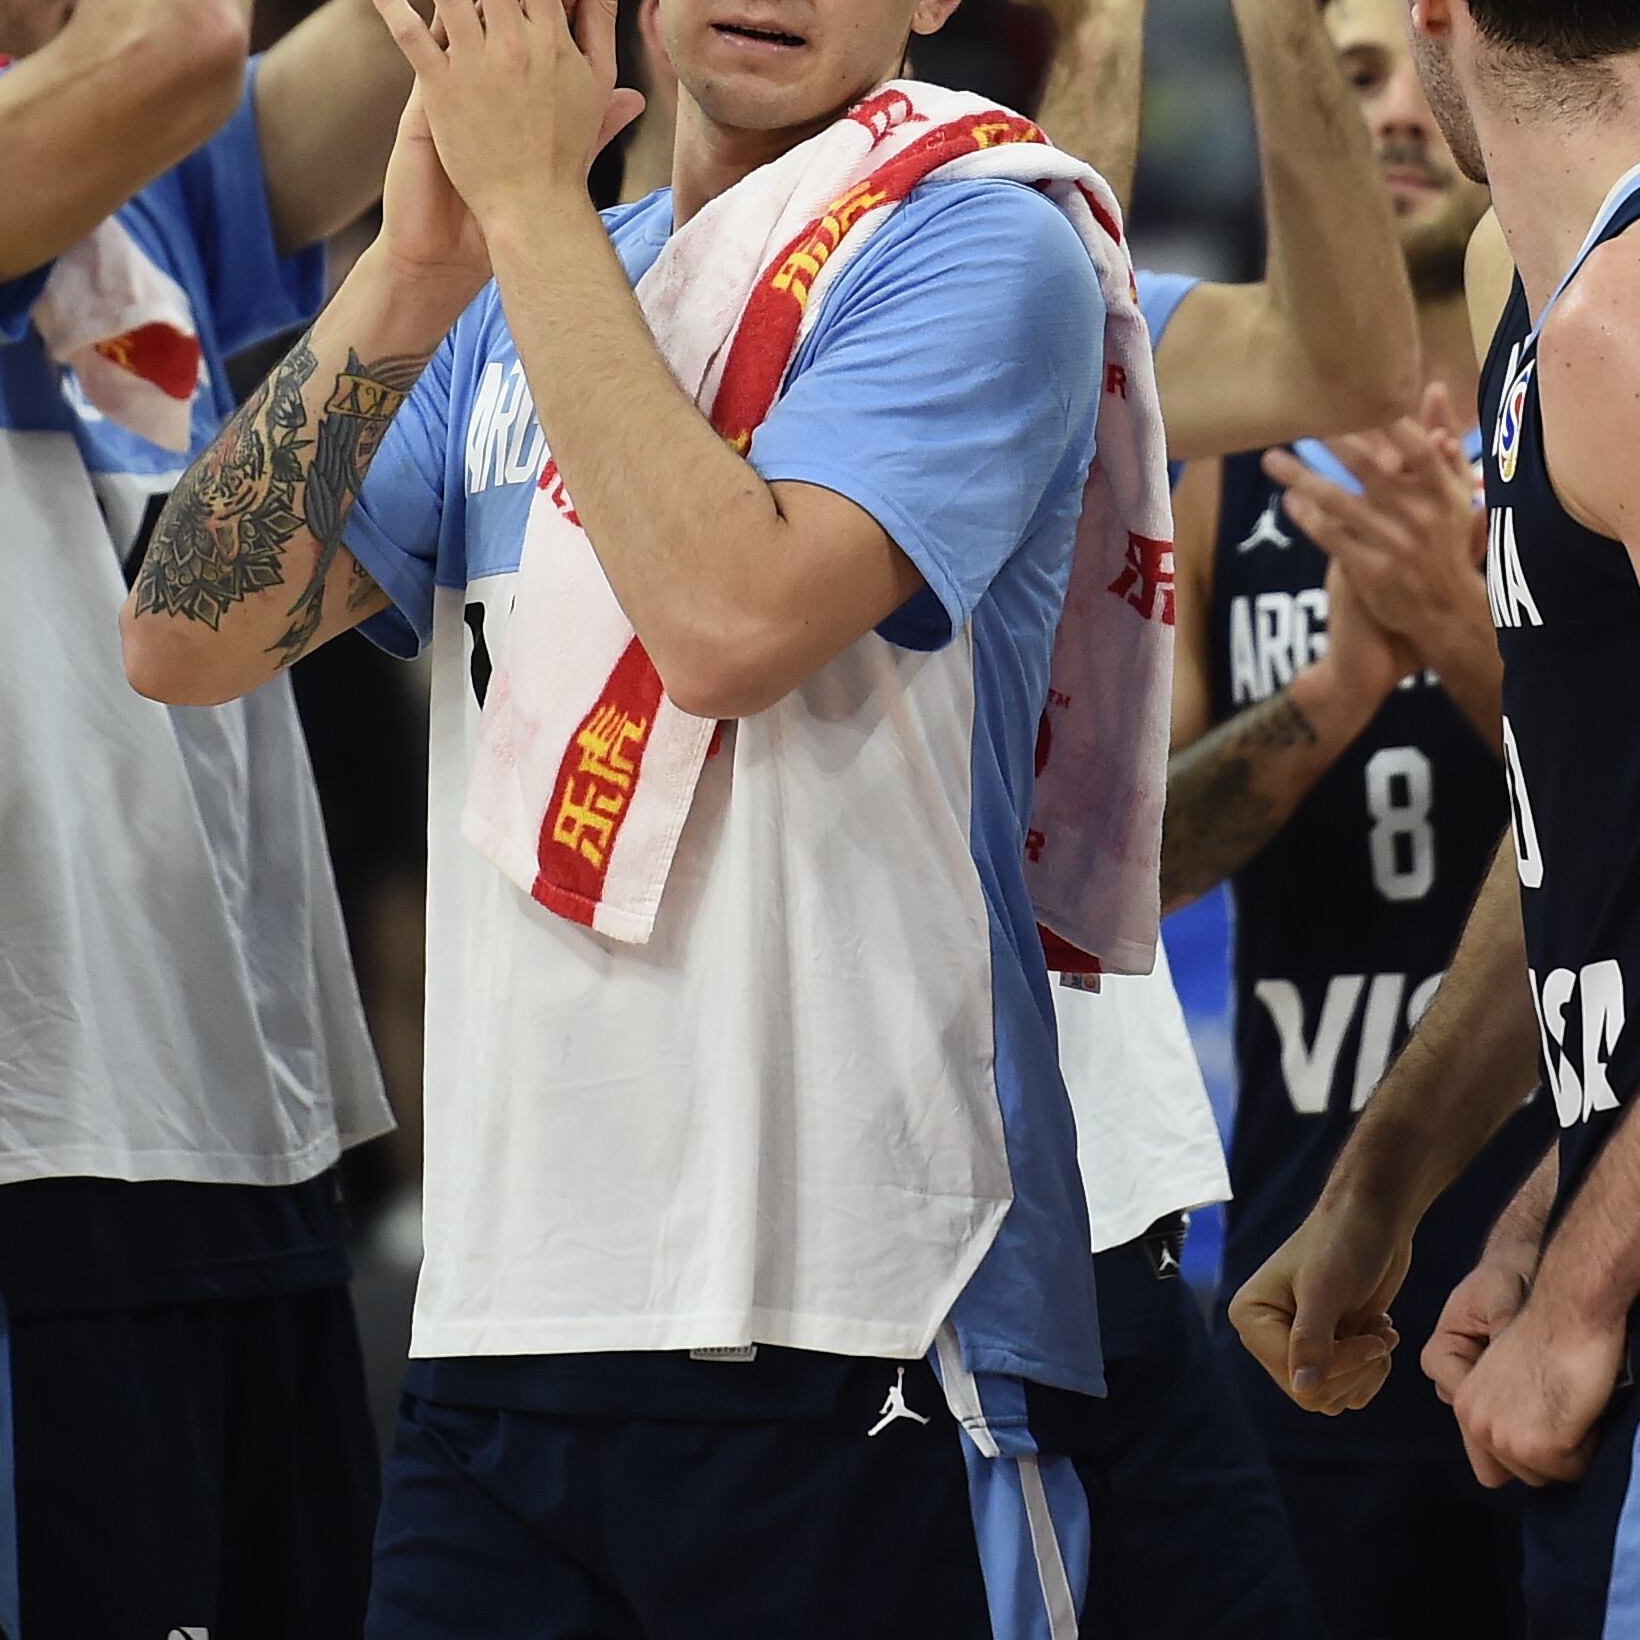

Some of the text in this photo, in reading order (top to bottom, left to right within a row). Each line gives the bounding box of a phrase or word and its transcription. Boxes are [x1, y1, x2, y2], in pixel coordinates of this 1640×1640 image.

[553, 704, 648, 868] 乐虎
[1364, 746, 1435, 901] 8
[1254, 971, 1449, 1115] VI
